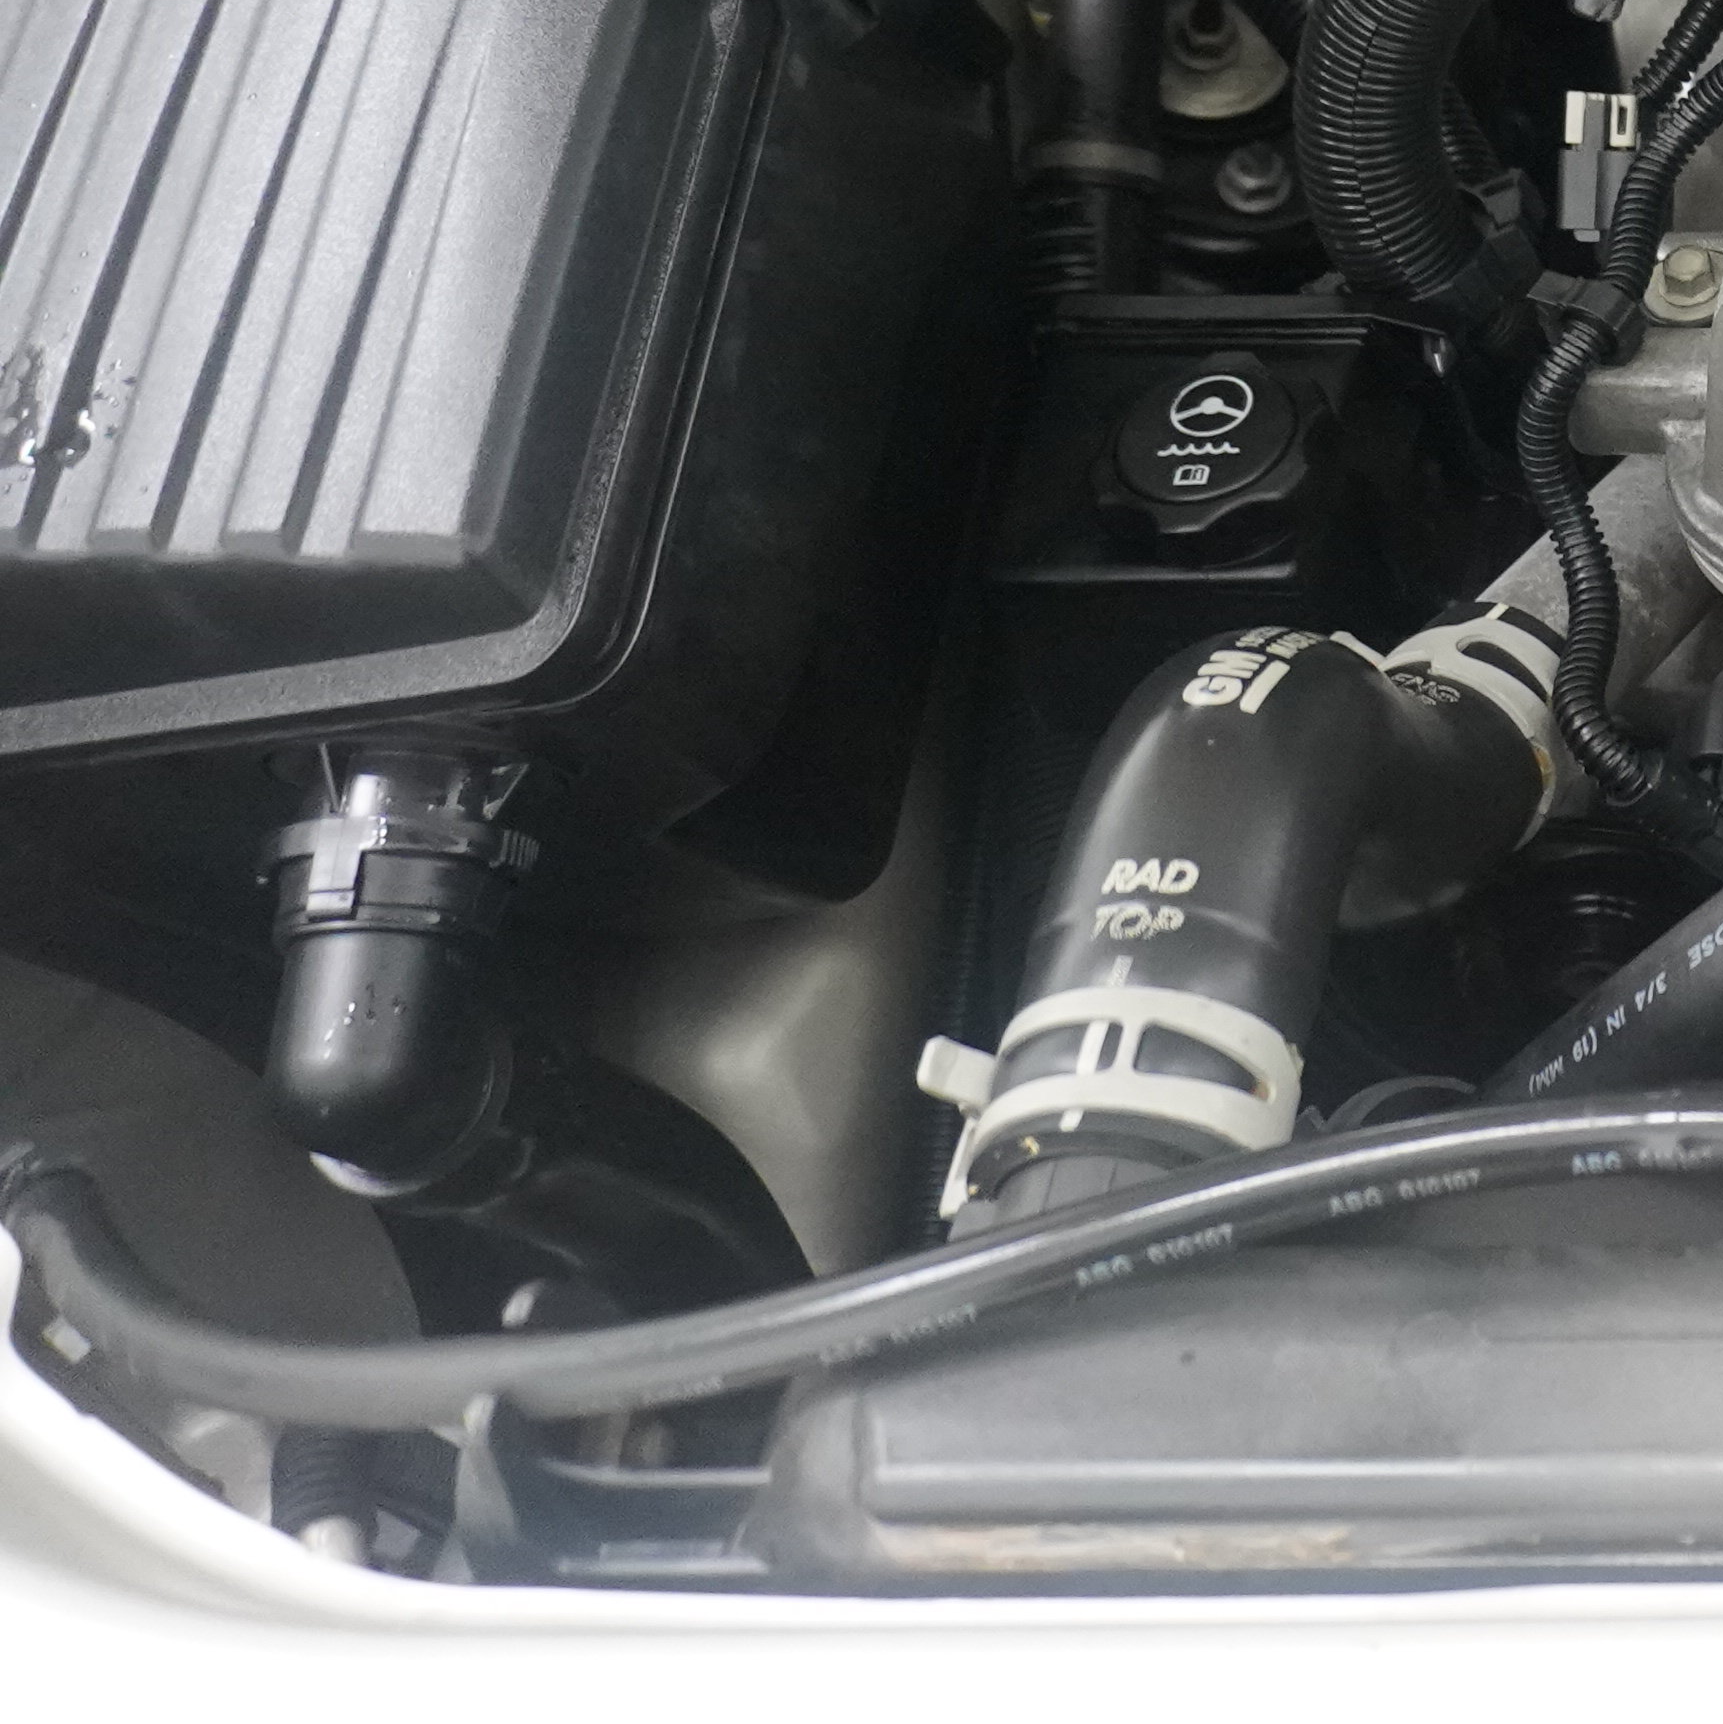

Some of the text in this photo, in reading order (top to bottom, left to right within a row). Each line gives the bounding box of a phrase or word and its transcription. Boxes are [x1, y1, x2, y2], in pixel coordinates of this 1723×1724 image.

[1182, 648, 1267, 707] GM
[1101, 858, 1200, 896] RAD
[1091, 903, 1185, 940] TOP
[1634, 970, 1667, 1012] 3/4
[1606, 1004, 1625, 1036] IN
[1572, 1025, 1598, 1062] (19
[1528, 1054, 1564, 1098] MM)
